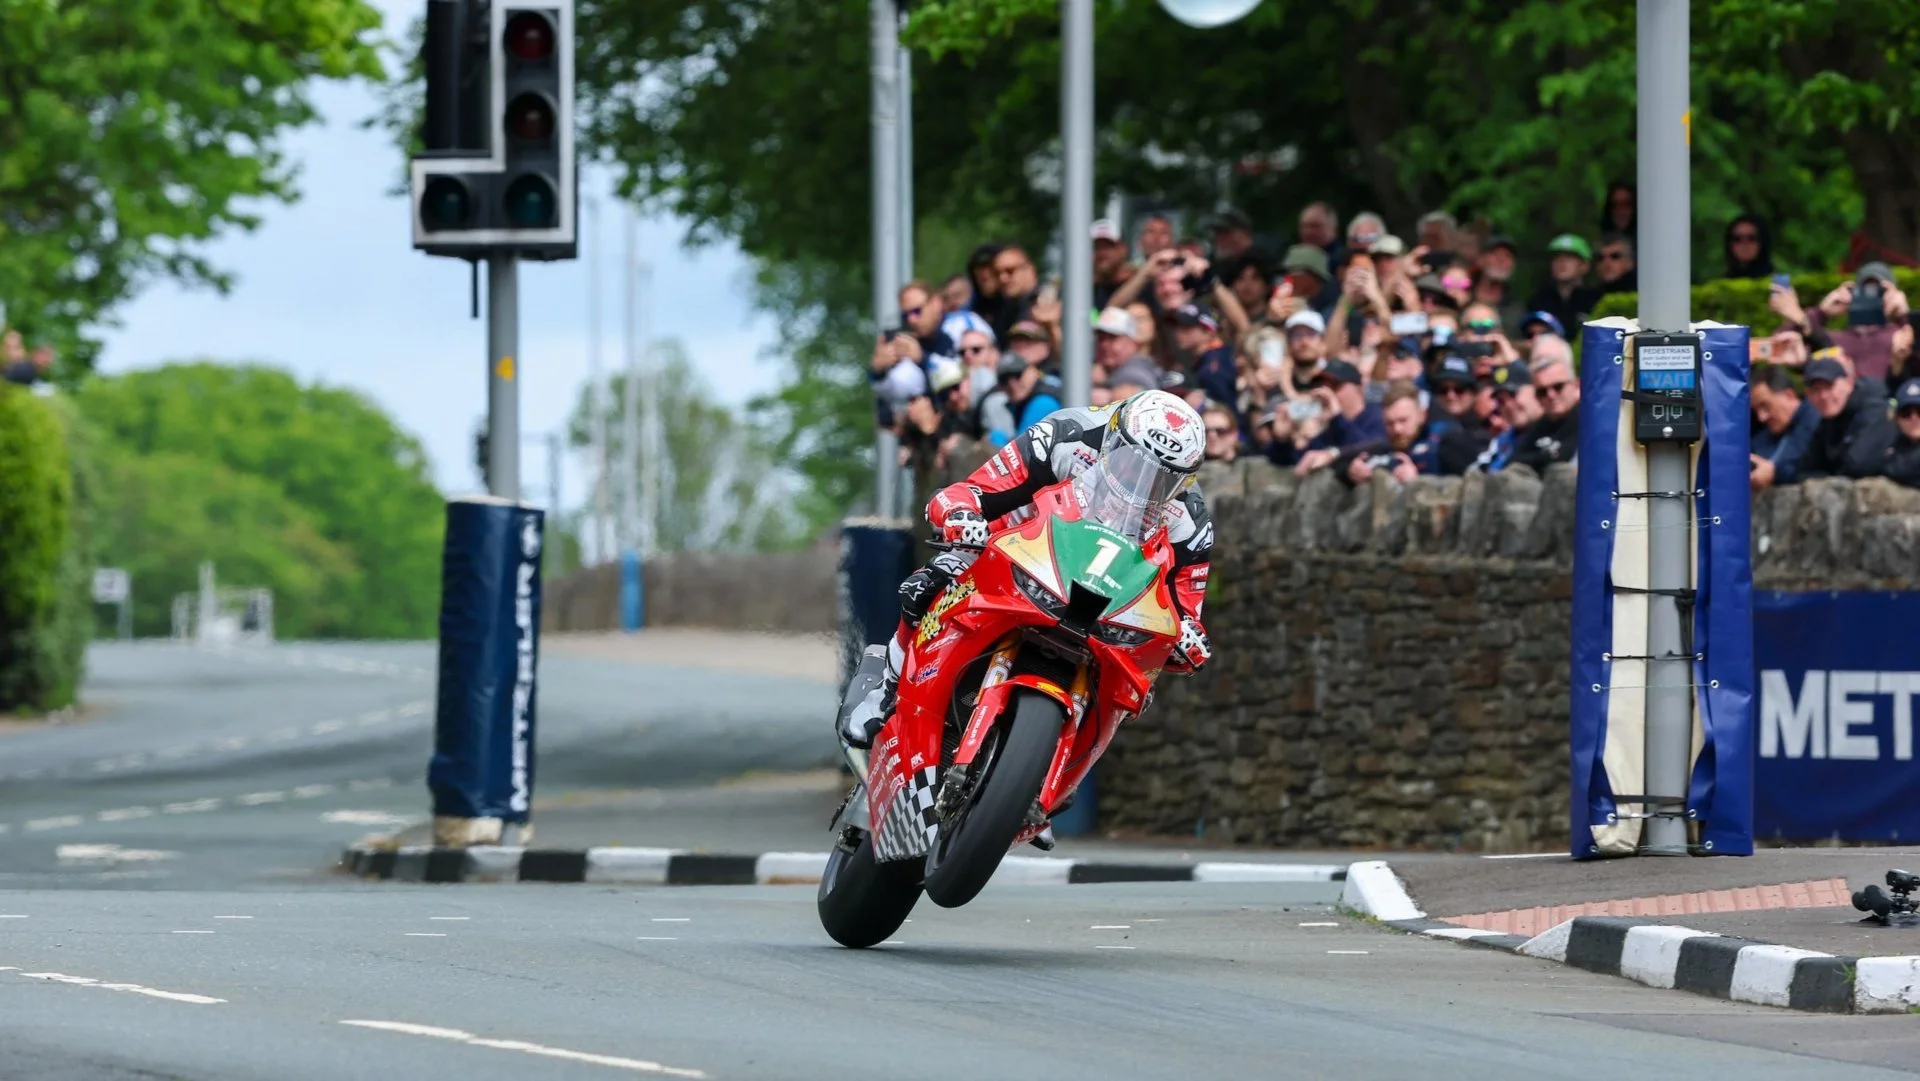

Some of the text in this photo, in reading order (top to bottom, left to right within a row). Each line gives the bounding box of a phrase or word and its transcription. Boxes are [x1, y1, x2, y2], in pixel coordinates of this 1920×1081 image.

[1643, 372, 1691, 387] WAIT
[1149, 430, 1180, 450] KYT
[1162, 502, 1183, 517] OTUL
[1084, 524, 1128, 544] METZELER
[1085, 537, 1122, 577] 1
[1759, 668, 1920, 761] MET
